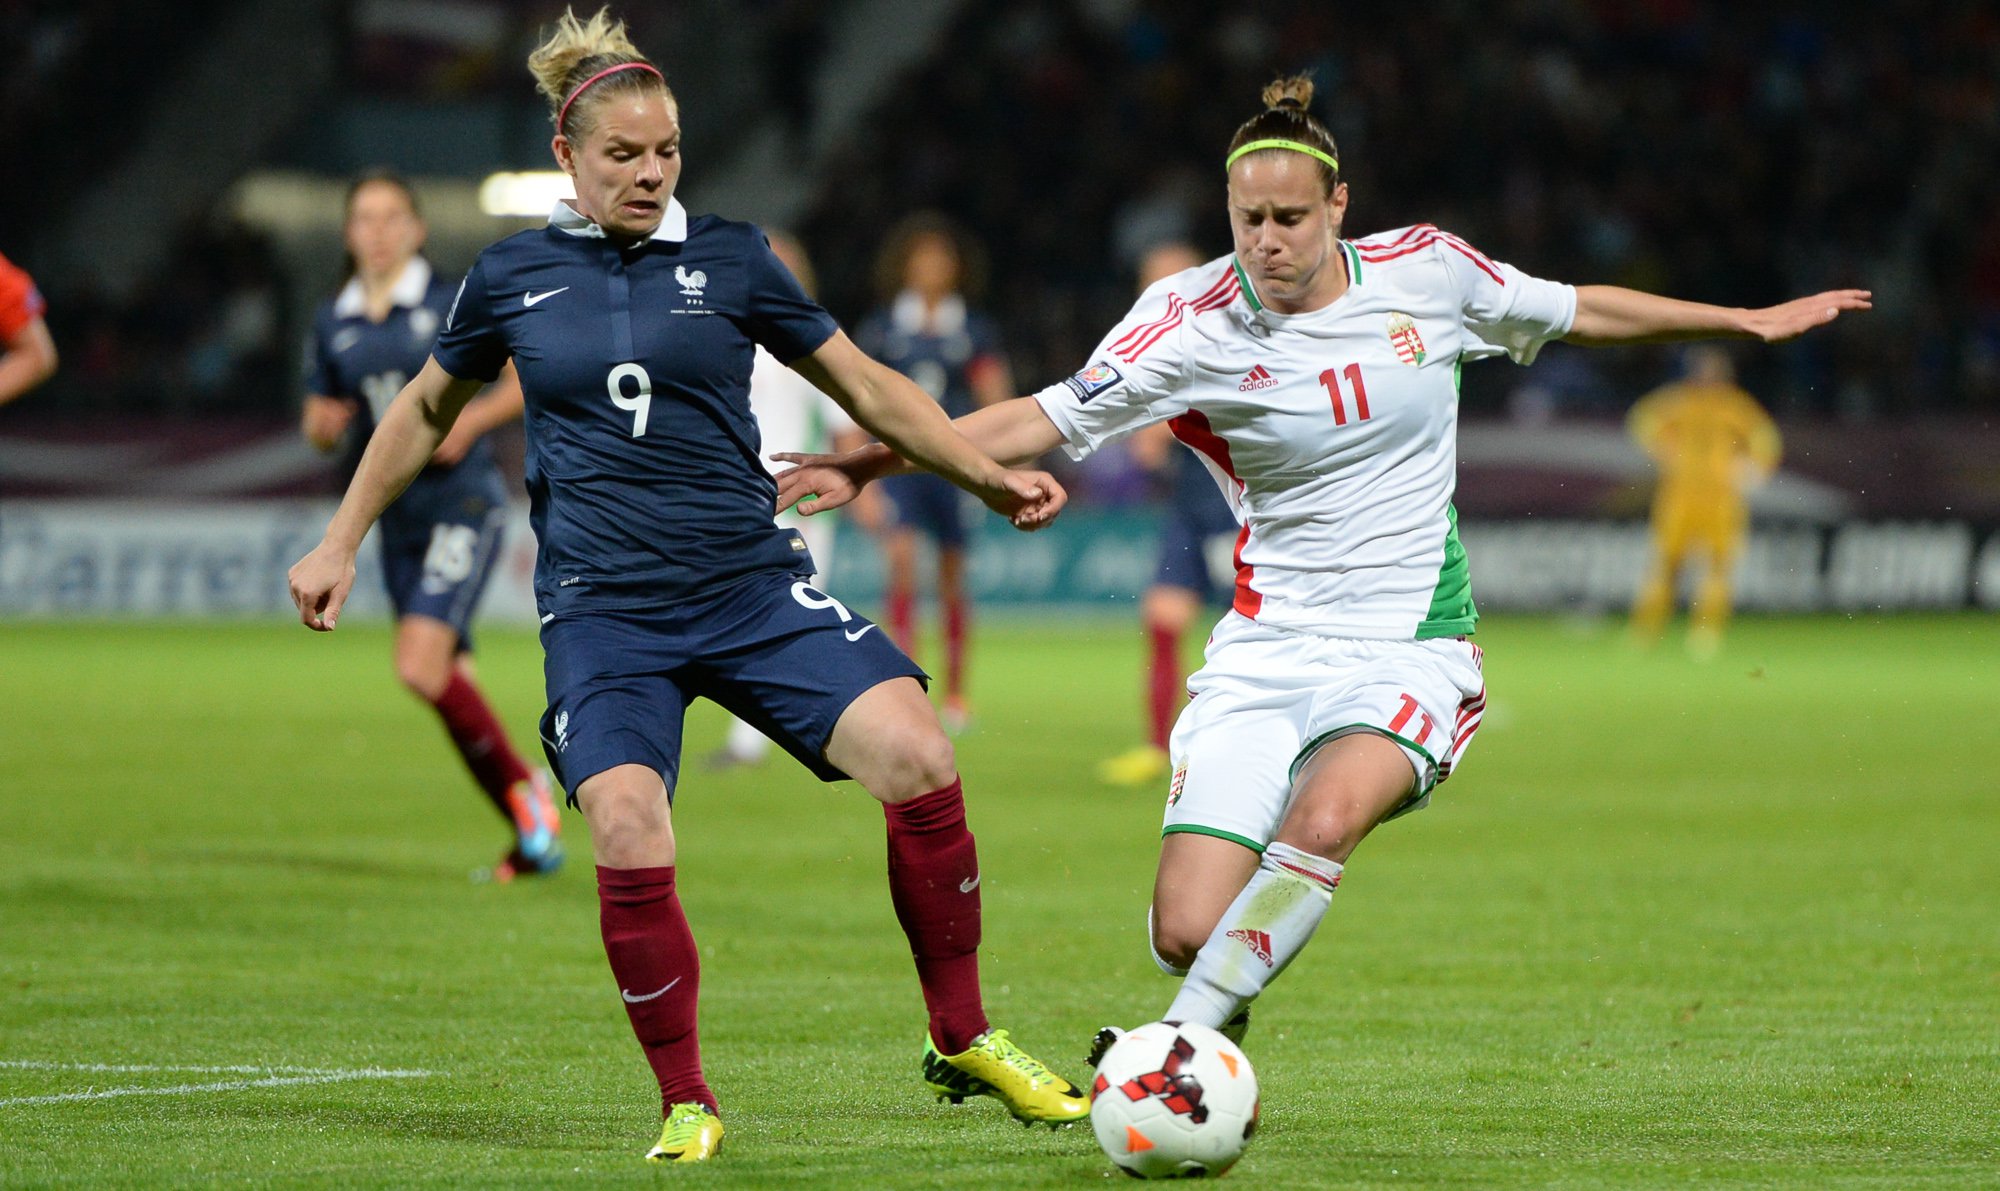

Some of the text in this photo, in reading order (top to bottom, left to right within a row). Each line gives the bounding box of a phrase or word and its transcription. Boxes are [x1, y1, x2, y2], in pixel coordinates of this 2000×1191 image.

[607, 362, 652, 438] 9
[1239, 379, 1279, 392] adidas
[1318, 362, 1371, 426] 11
[790, 581, 853, 623] 9
[1388, 692, 1434, 747] 11
[1226, 929, 1274, 969] adidas
